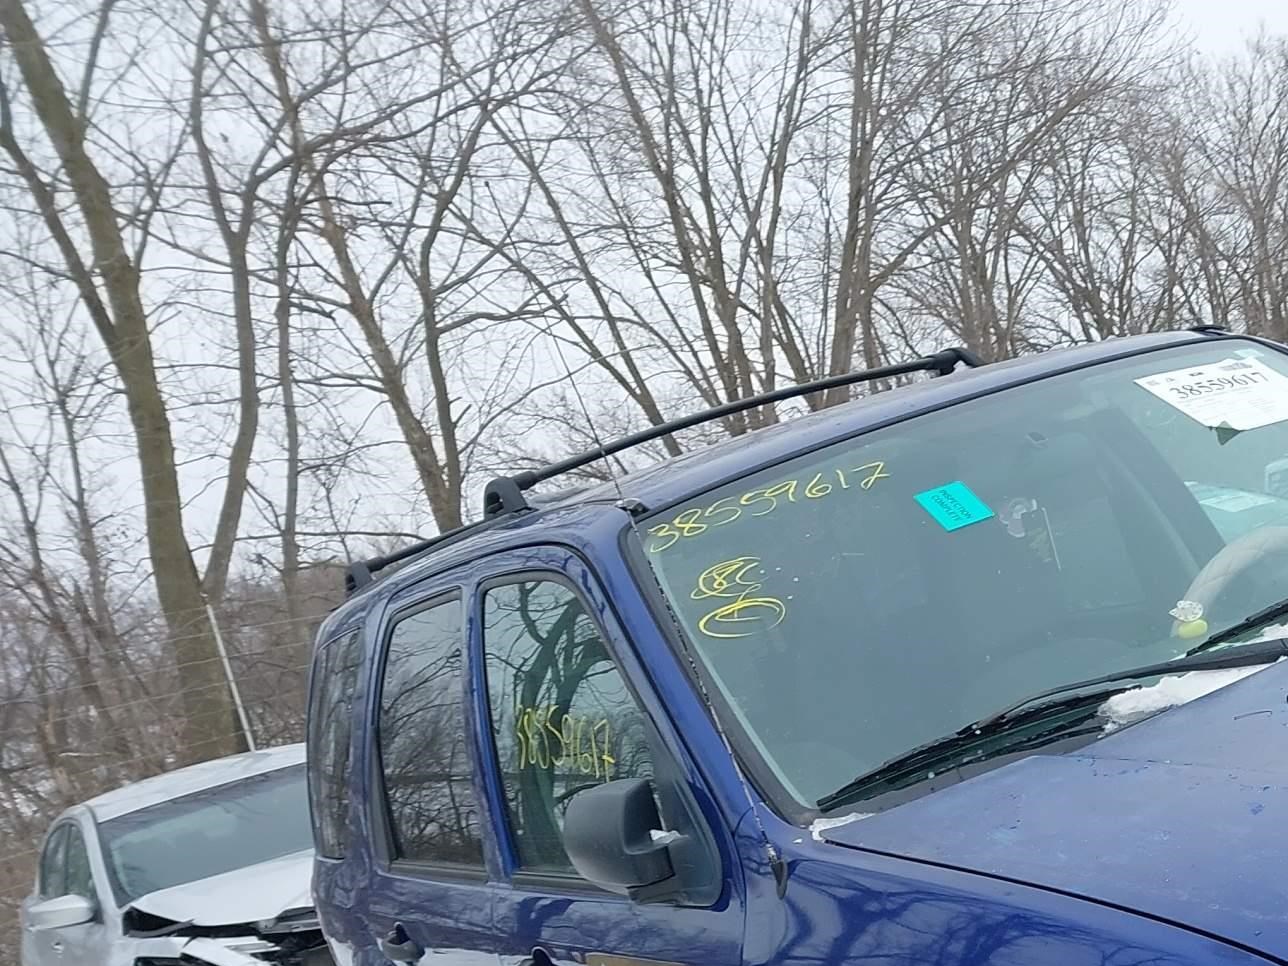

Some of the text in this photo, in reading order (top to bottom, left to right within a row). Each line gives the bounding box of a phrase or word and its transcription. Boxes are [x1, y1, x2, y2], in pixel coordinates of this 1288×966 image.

[1169, 371, 1269, 399] 38559617
[647, 461, 891, 553] 38559617
[938, 489, 972, 519] INSPECTION
